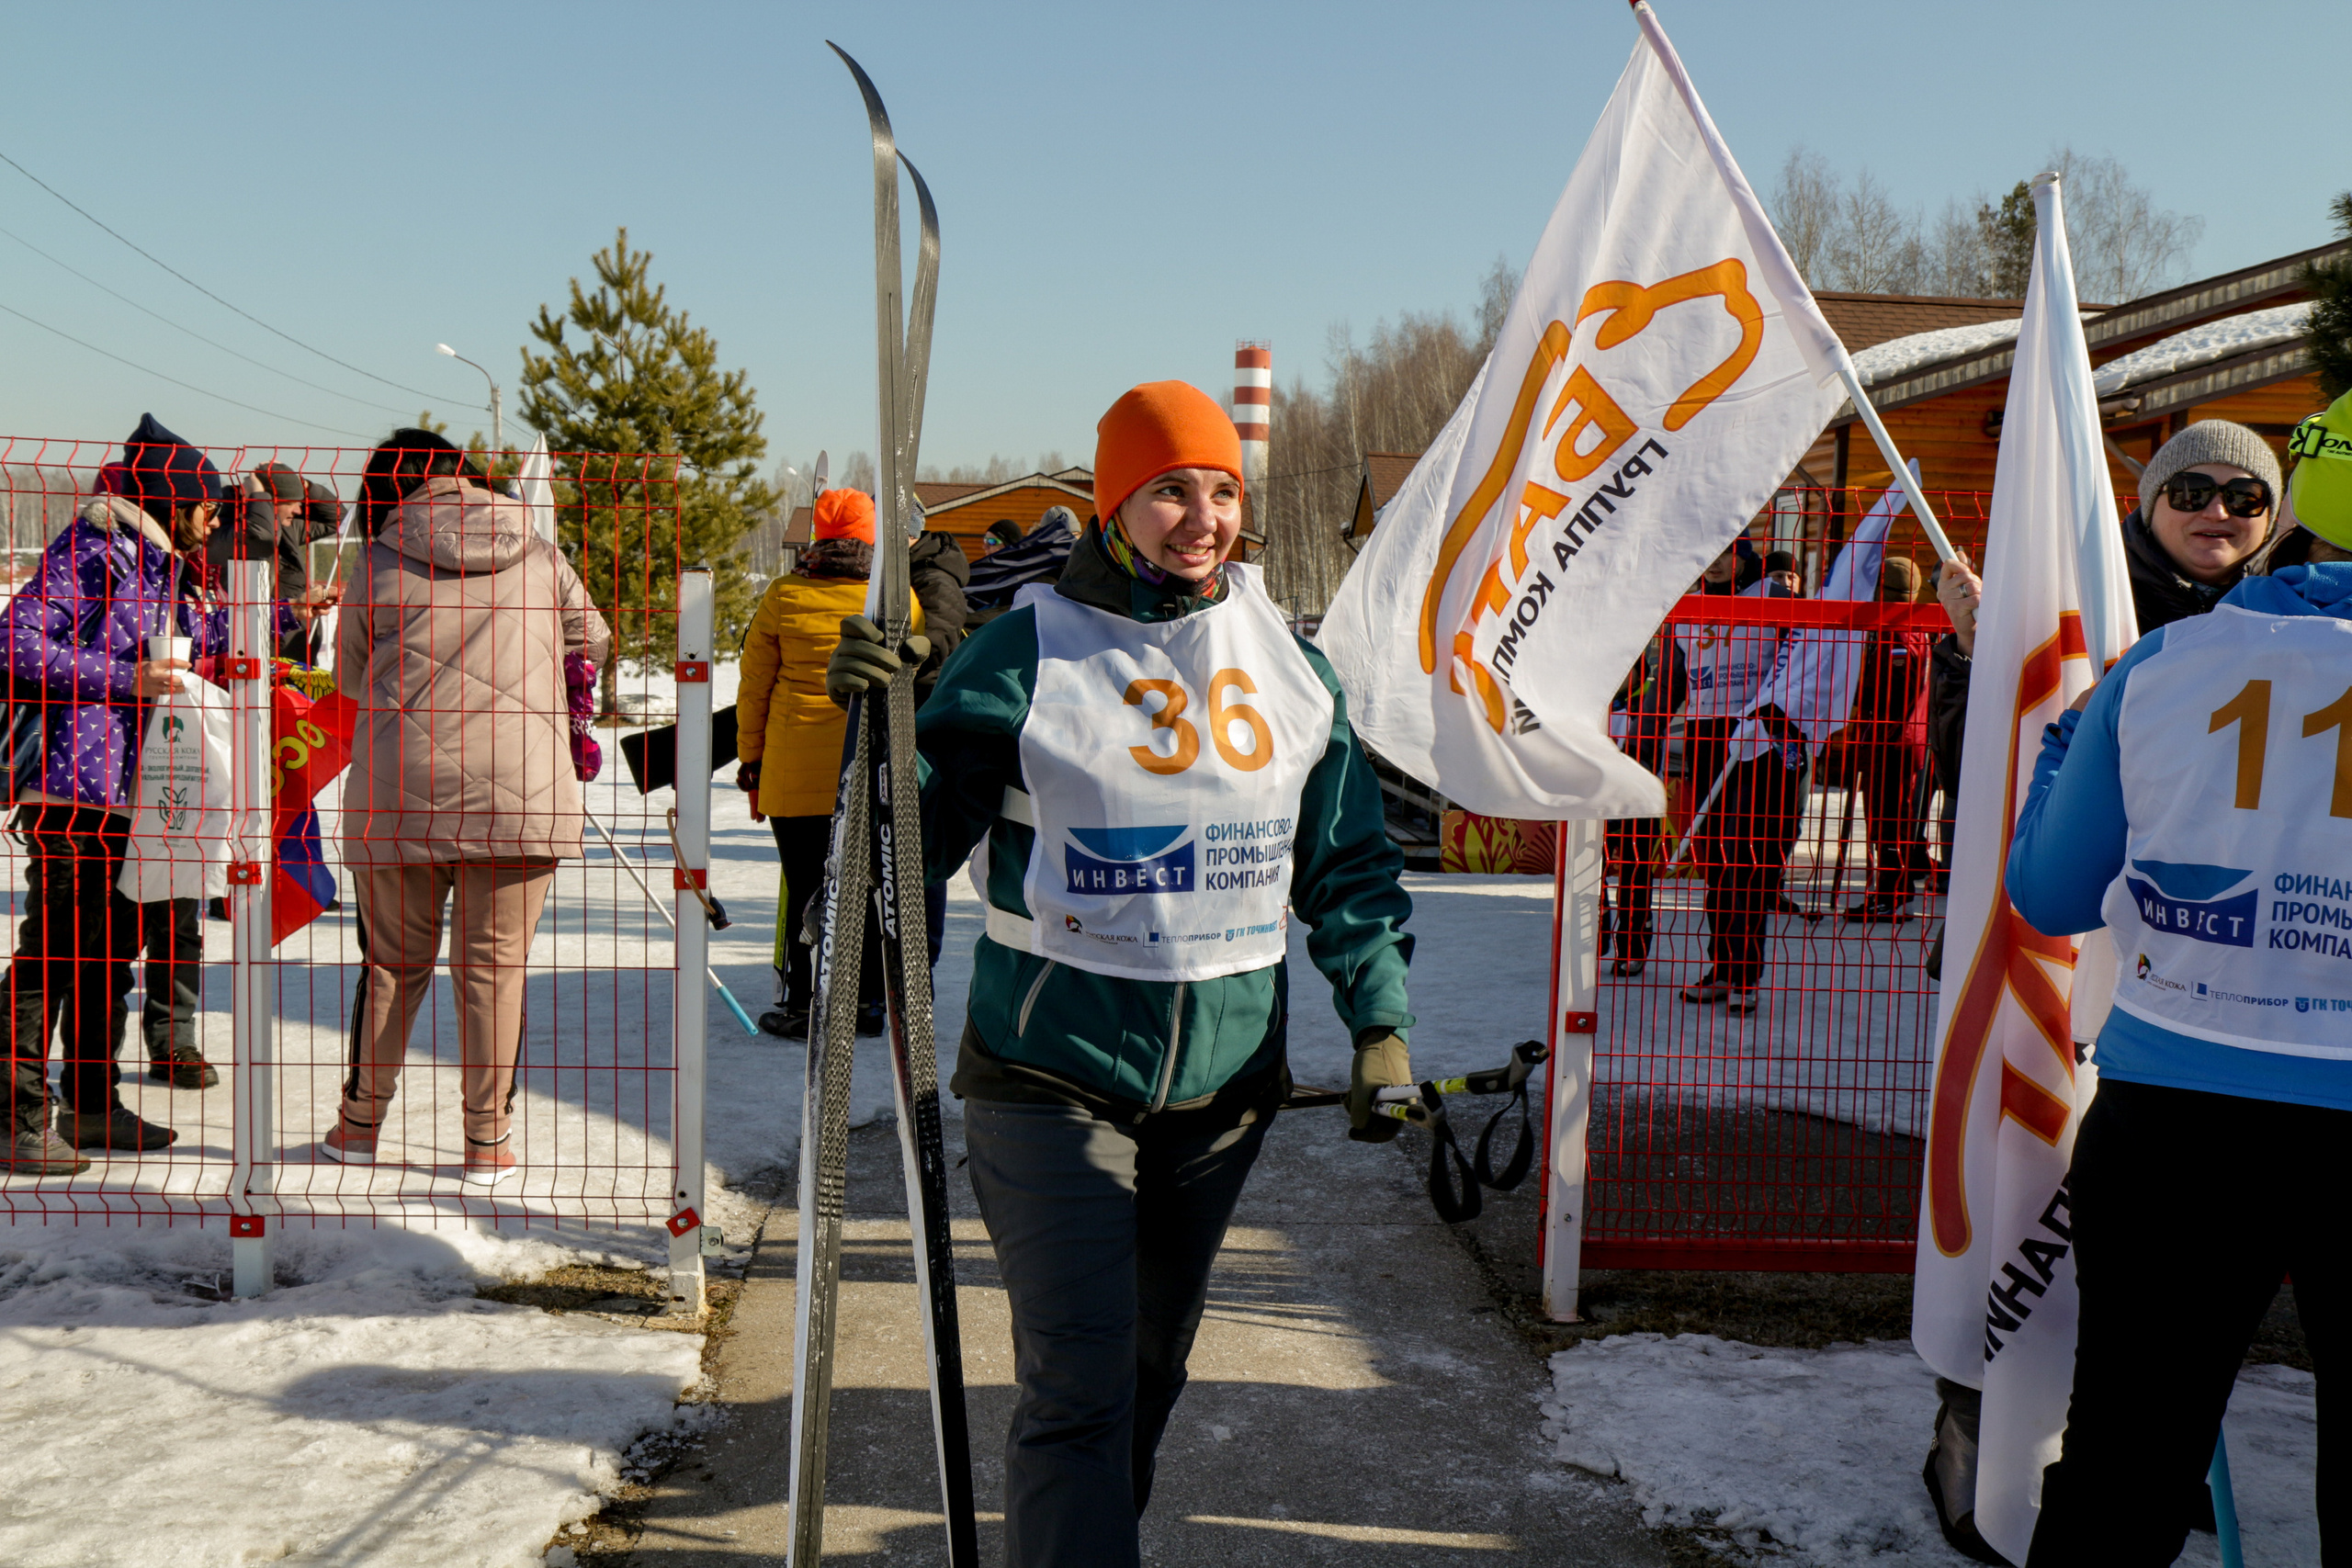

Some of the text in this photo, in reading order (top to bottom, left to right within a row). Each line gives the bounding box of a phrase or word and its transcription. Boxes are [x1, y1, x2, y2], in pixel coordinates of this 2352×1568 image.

[1123, 668, 1274, 775] 36
[2208, 680, 2352, 818] 11
[1205, 818, 1293, 842] ФИНАНСОВО-
[880, 823, 897, 939] ATOMIC
[1072, 865, 1186, 888] ИНВЕСТ
[1206, 864, 1281, 890] КОМПАНИЯ
[1116, 935, 1138, 943] КОЖА
[1161, 932, 1222, 943] ТЕПЛОПРИБОР
[2165, 979, 2187, 992] КОЖА
[2210, 990, 2289, 1008] ТЕПЛОПРИБОР
[2312, 998, 2327, 1011] ГК
